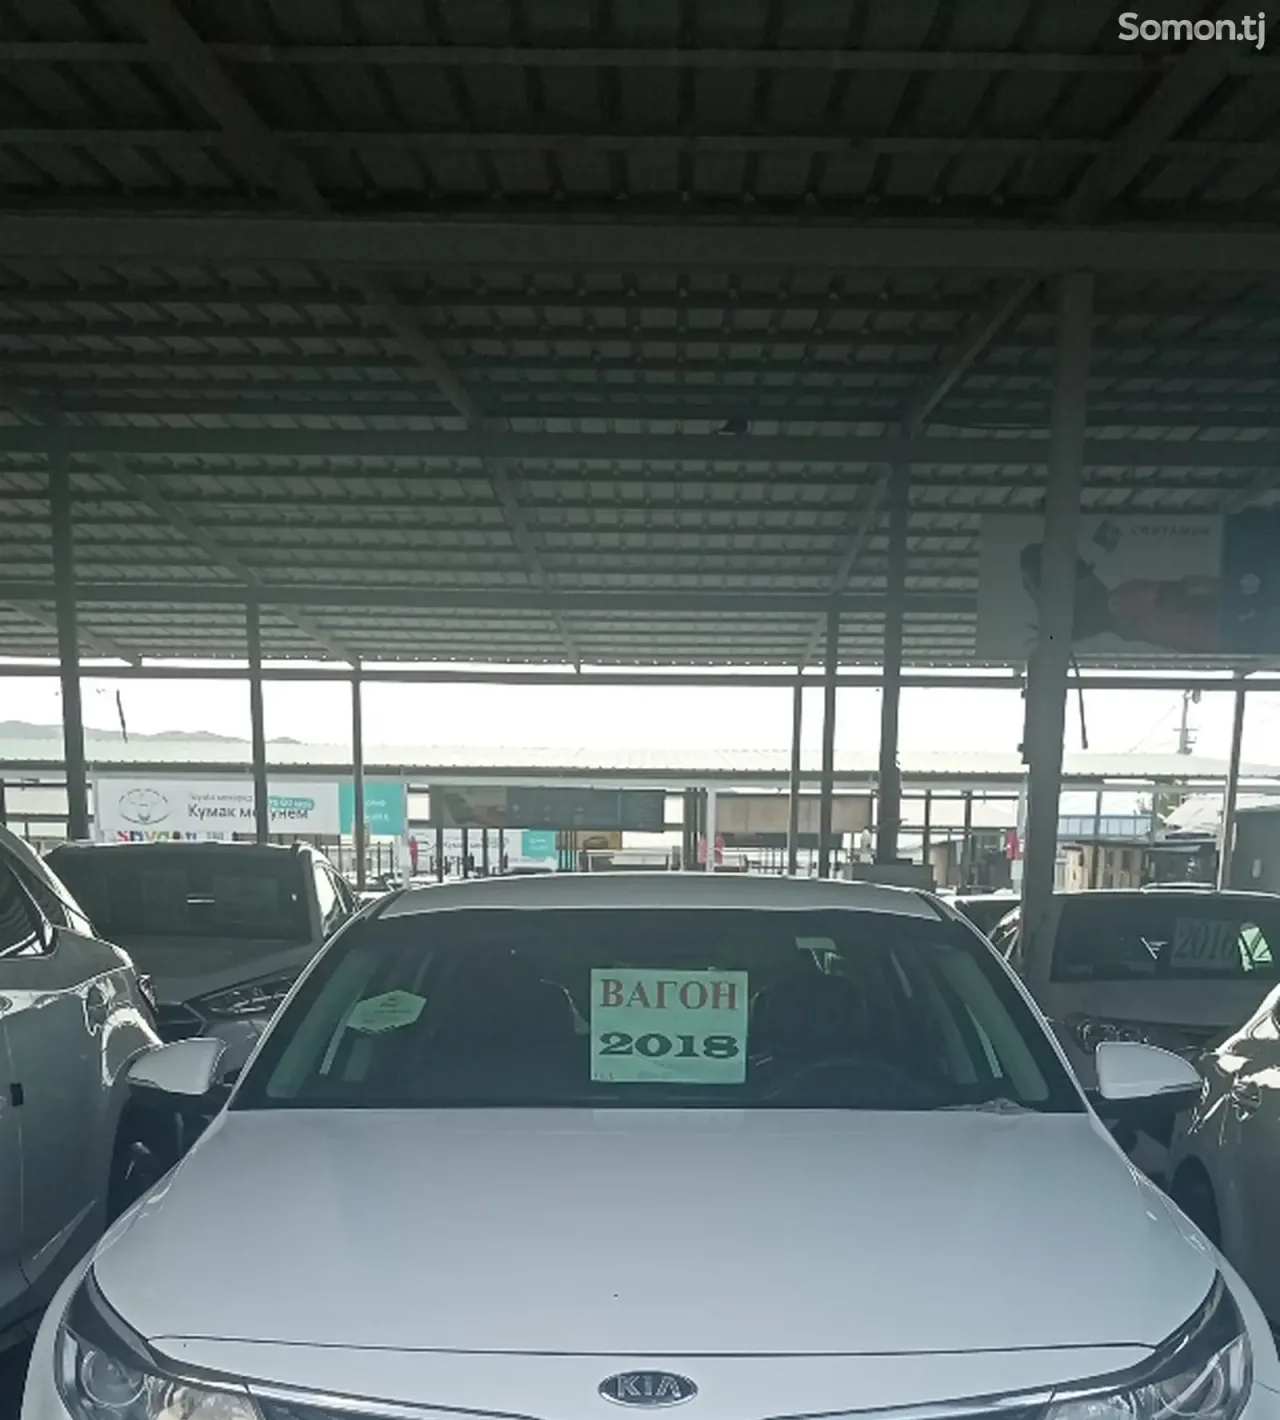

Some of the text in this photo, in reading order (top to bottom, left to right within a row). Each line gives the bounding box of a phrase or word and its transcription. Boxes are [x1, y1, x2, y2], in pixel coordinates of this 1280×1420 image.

[188, 803, 236, 821] Кумак
[599, 979, 739, 1010] ВАГОН
[599, 1032, 739, 1059] 2018
[617, 1375, 682, 1398] KIA
